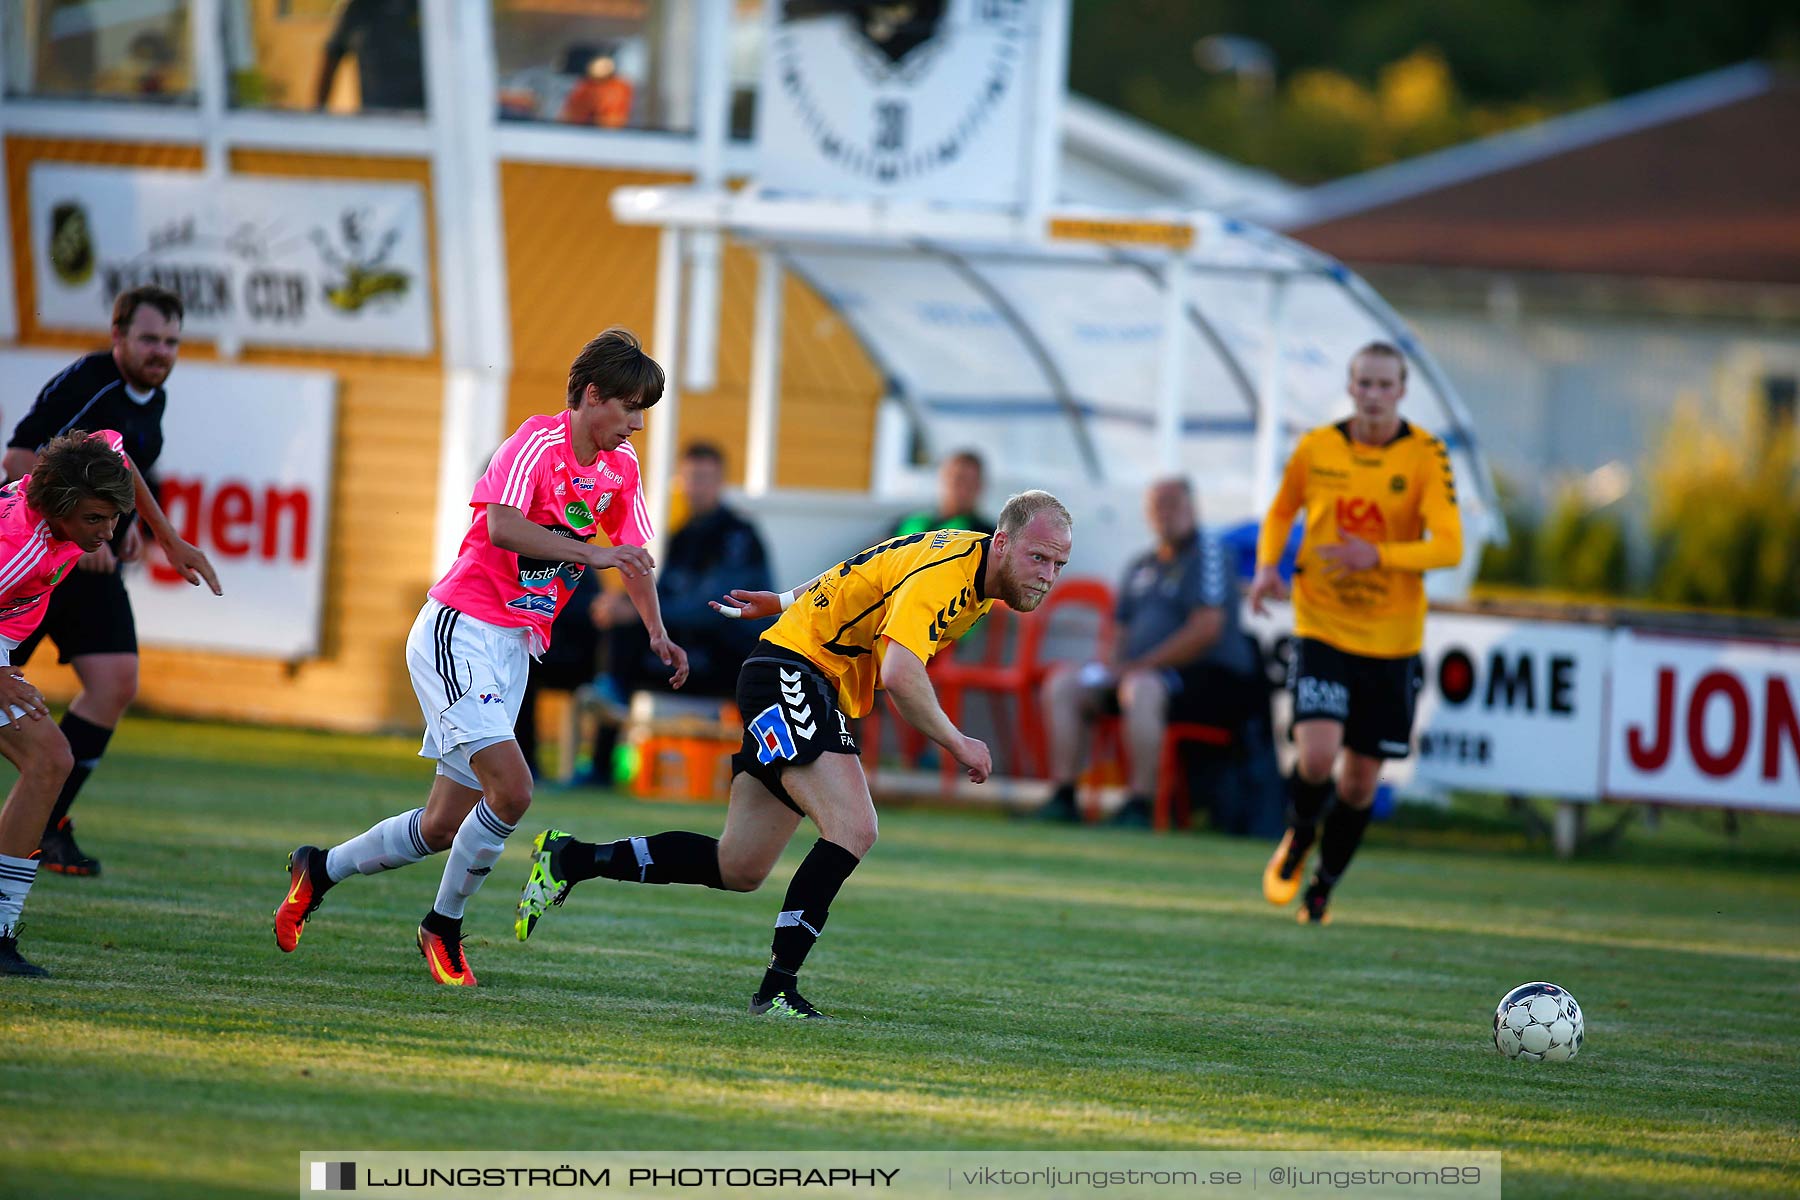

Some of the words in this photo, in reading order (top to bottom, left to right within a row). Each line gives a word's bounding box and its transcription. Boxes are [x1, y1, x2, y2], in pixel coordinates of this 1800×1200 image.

[1336, 496, 1386, 538] ICA
[1438, 648, 1577, 716] OME
[1418, 732, 1492, 763] NTER
